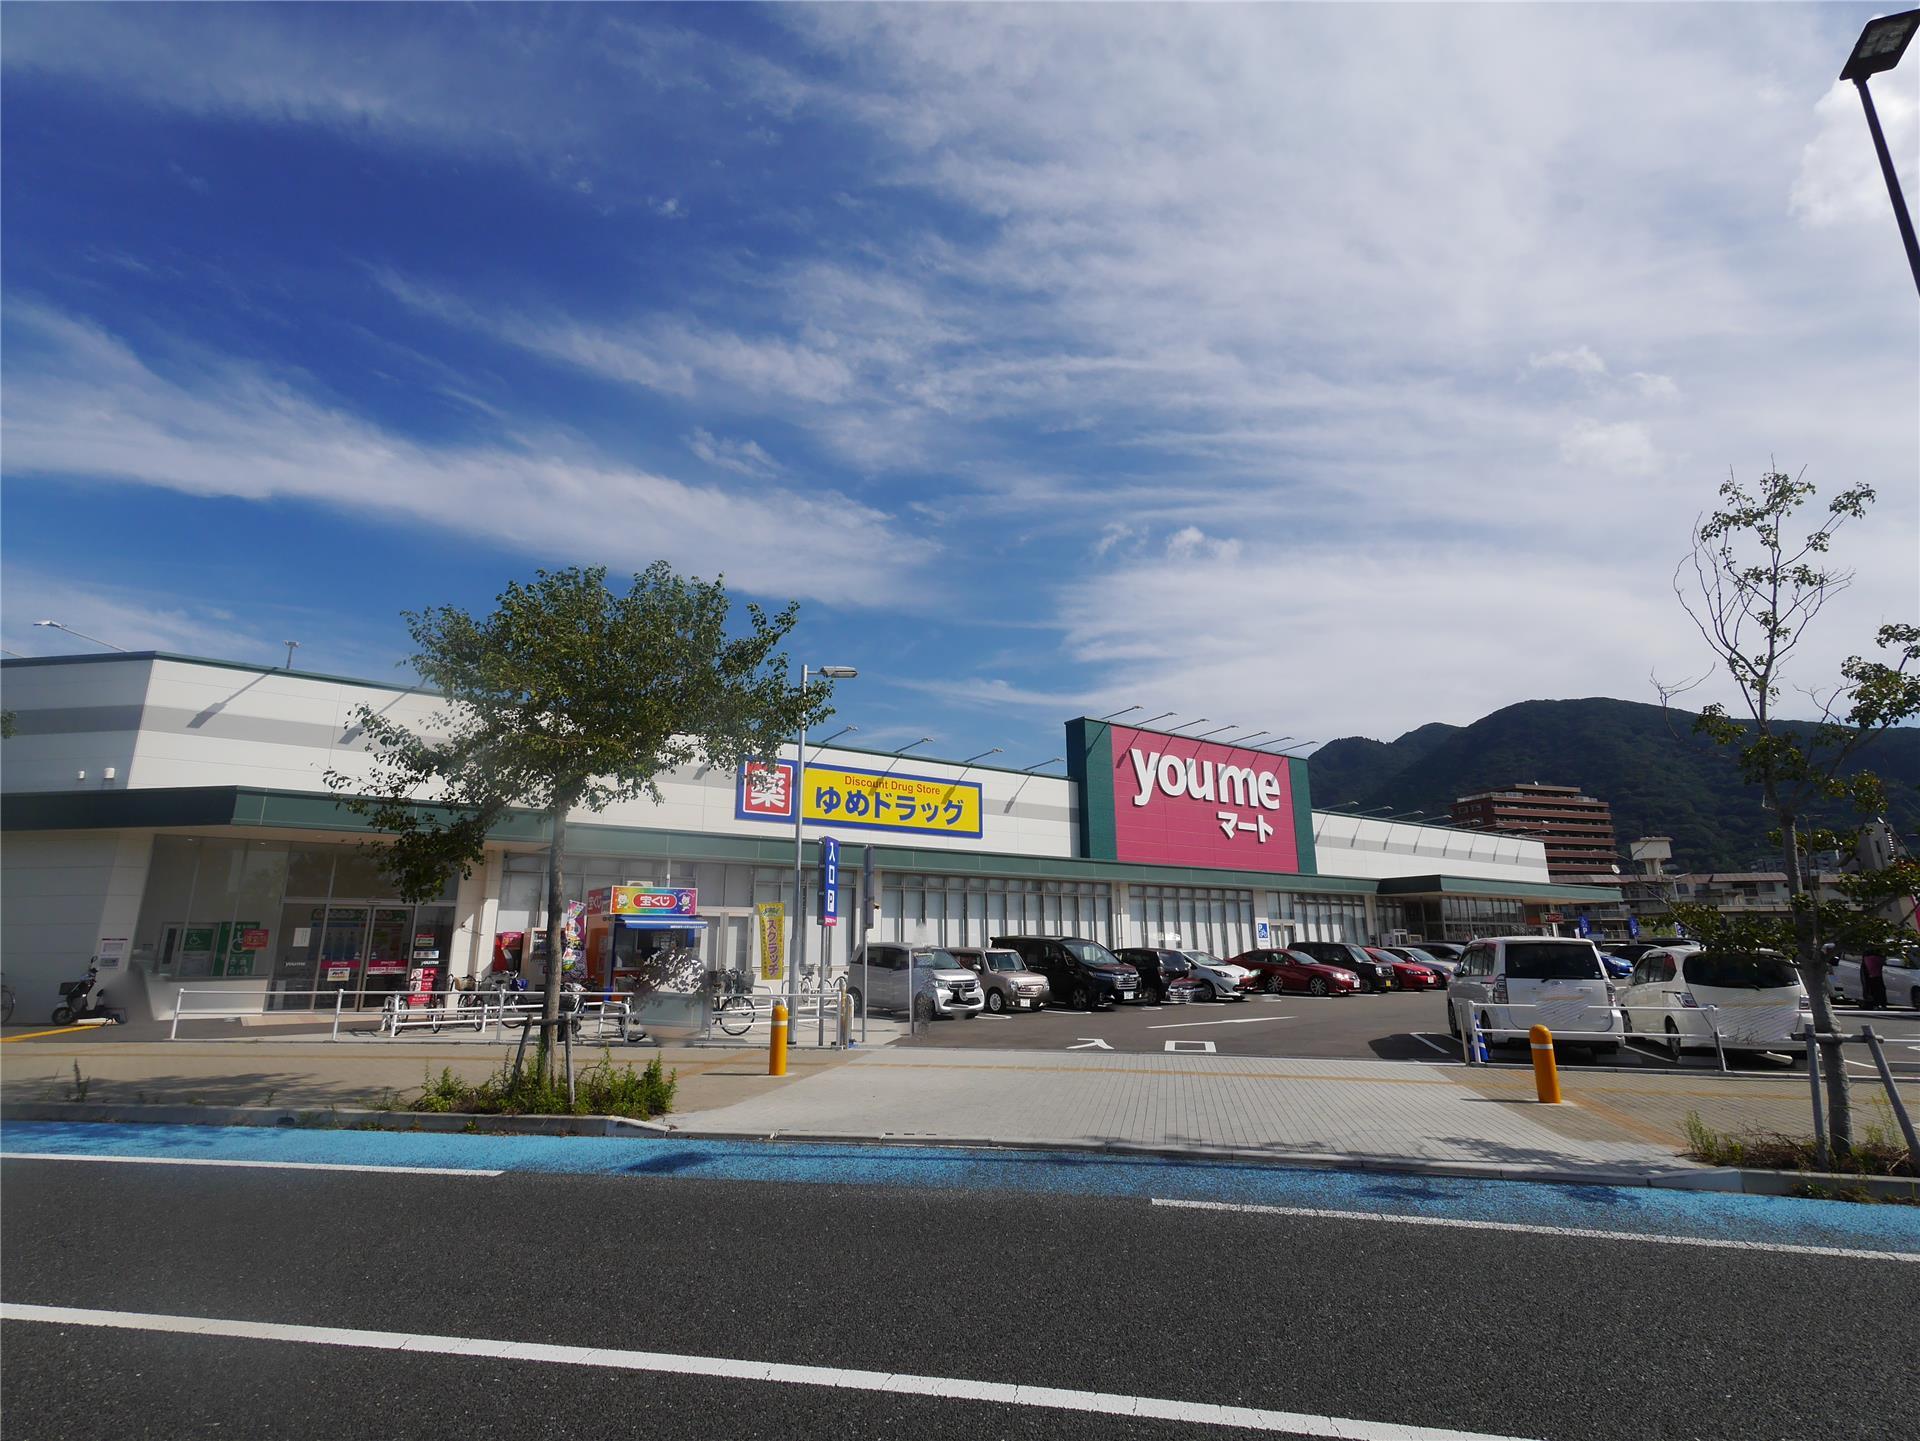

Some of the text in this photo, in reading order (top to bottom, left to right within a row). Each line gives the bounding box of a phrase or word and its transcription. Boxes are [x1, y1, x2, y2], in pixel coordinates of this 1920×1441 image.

[845, 775, 941, 795] Discount Drug Store
[1129, 748, 1281, 810] youme
[815, 786, 964, 825] ゆめドラッグ
[1217, 811, 1274, 843] マート
[639, 895, 671, 907] 宝くじ
[767, 919, 779, 976] スクラッチ
